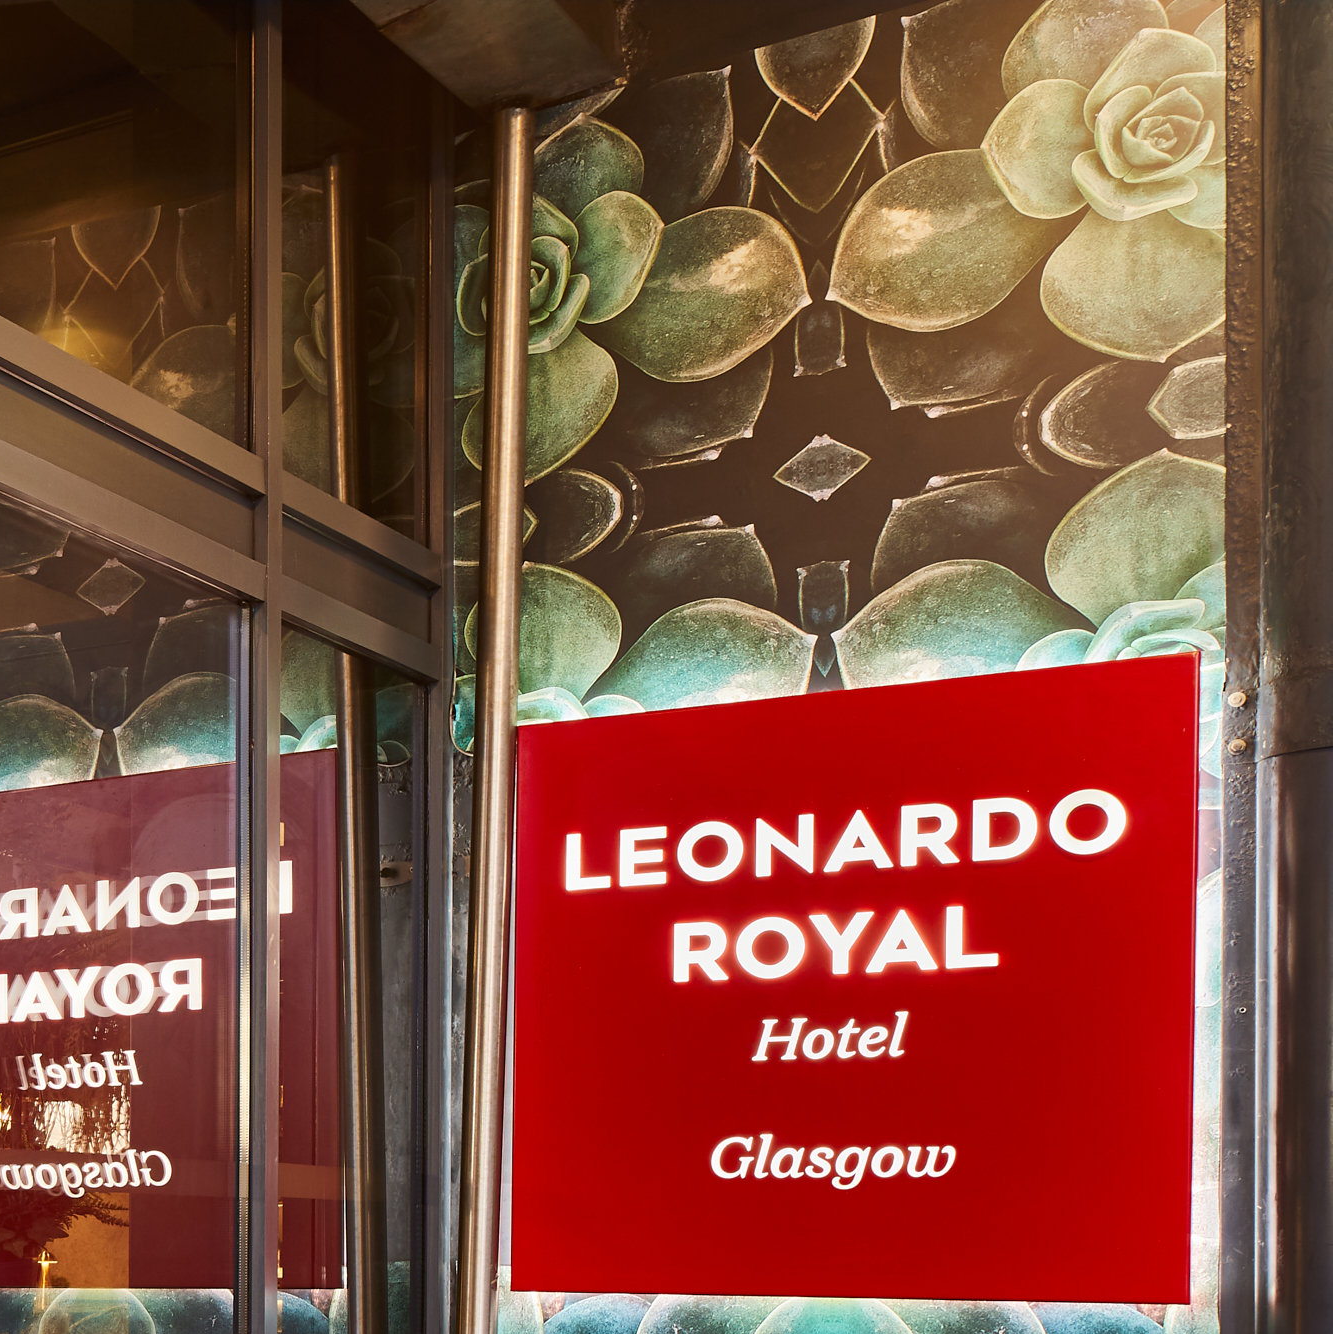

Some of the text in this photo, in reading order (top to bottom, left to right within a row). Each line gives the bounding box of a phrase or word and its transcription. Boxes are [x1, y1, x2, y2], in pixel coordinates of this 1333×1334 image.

[565, 787, 1129, 892] LEONARDO
[671, 905, 1000, 984] ROYAL
[751, 1010, 909, 1062] Hotel
[709, 1133, 958, 1190] Glasgow
